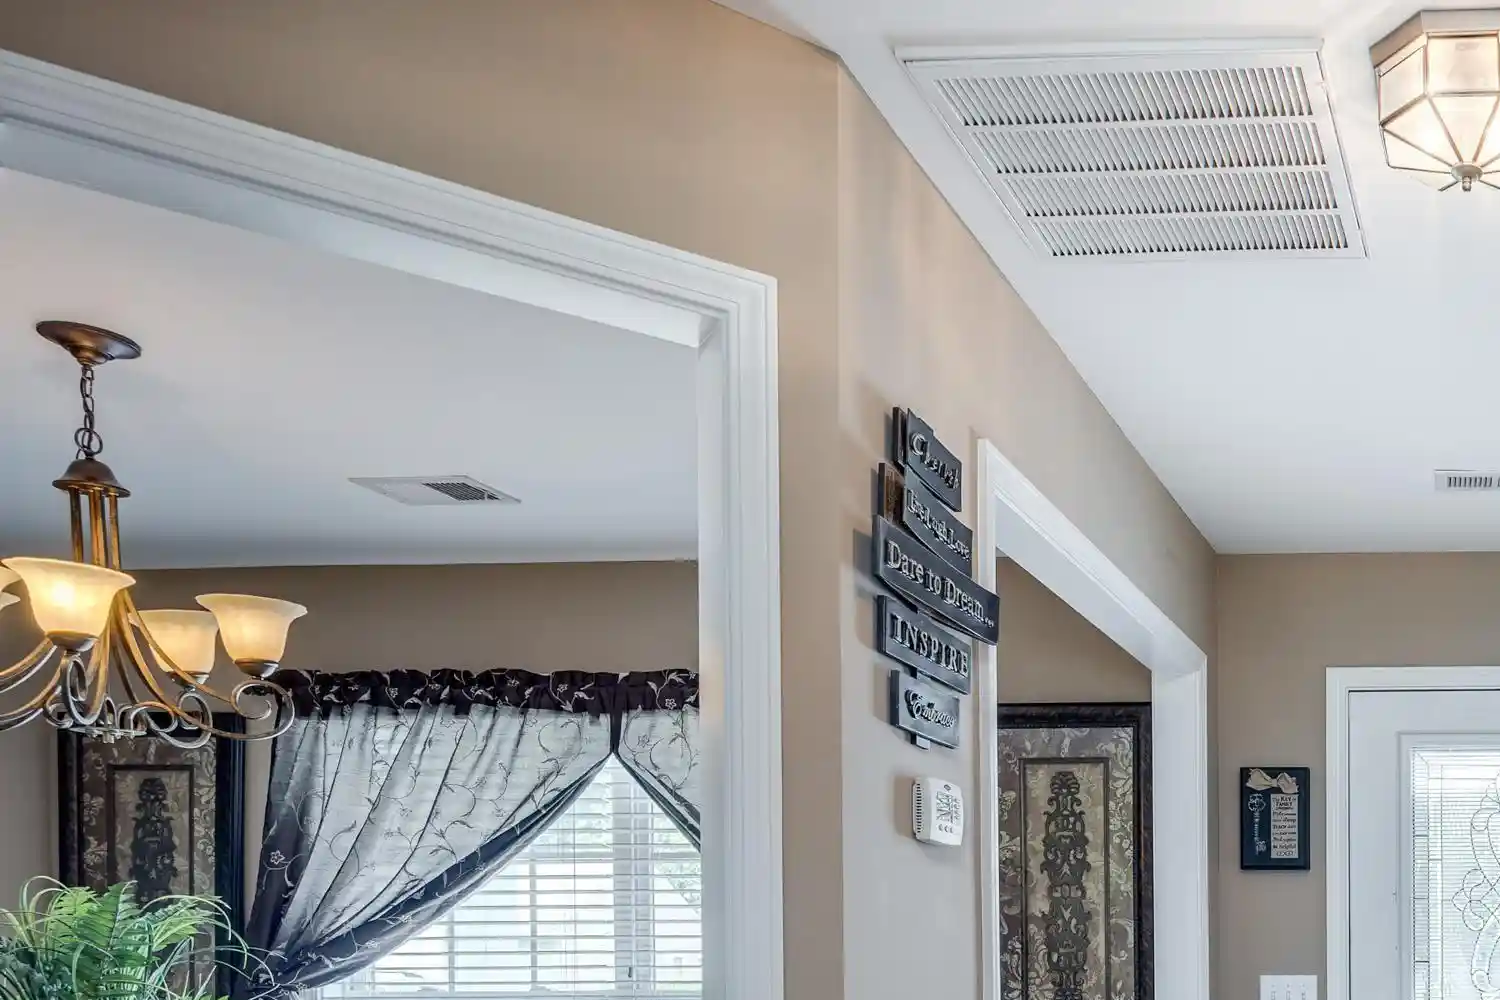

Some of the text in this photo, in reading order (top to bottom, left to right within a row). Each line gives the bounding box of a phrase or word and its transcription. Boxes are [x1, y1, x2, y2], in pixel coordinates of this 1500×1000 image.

[884, 540, 925, 584] Dare
[925, 568, 942, 595] to
[892, 611, 969, 679] INSPIRE
